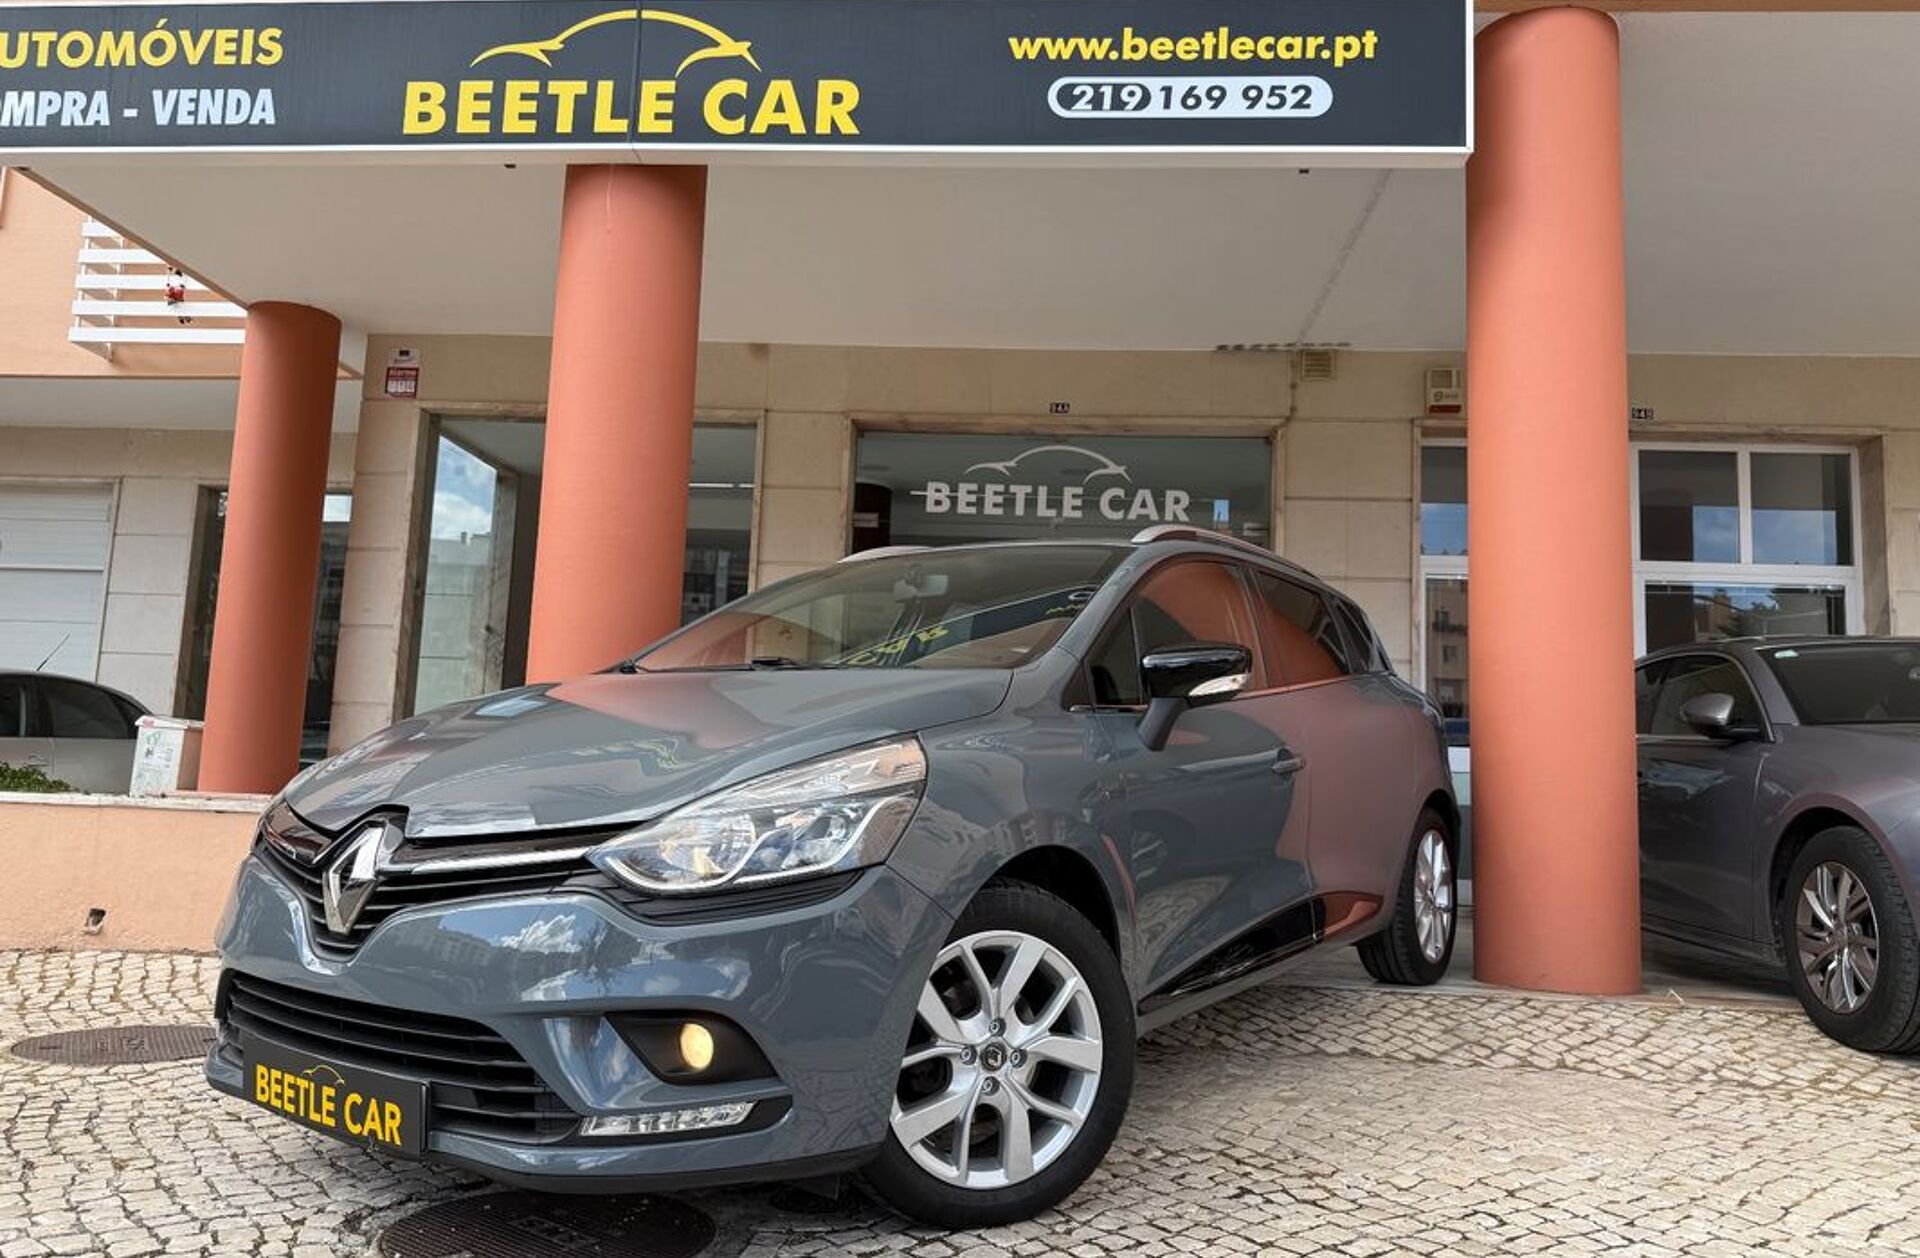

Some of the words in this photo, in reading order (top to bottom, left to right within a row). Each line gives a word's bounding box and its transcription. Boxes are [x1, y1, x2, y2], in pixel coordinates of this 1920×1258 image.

[0, 18, 284, 68] UTOMÓVEIS
[1008, 27, 1379, 67] www.beetlecar.pt
[0, 89, 110, 127] MPRA
[152, 88, 276, 126] VENDA
[402, 80, 677, 135] BEETLE
[703, 78, 861, 135] CAR
[1071, 84, 1144, 112] 219
[1159, 84, 1228, 110] 169
[1241, 84, 1313, 110] 952
[925, 480, 1084, 519] BEETLE
[1099, 486, 1191, 522] CAR
[255, 1063, 336, 1128] BEETLE
[344, 1091, 402, 1146] CAR
